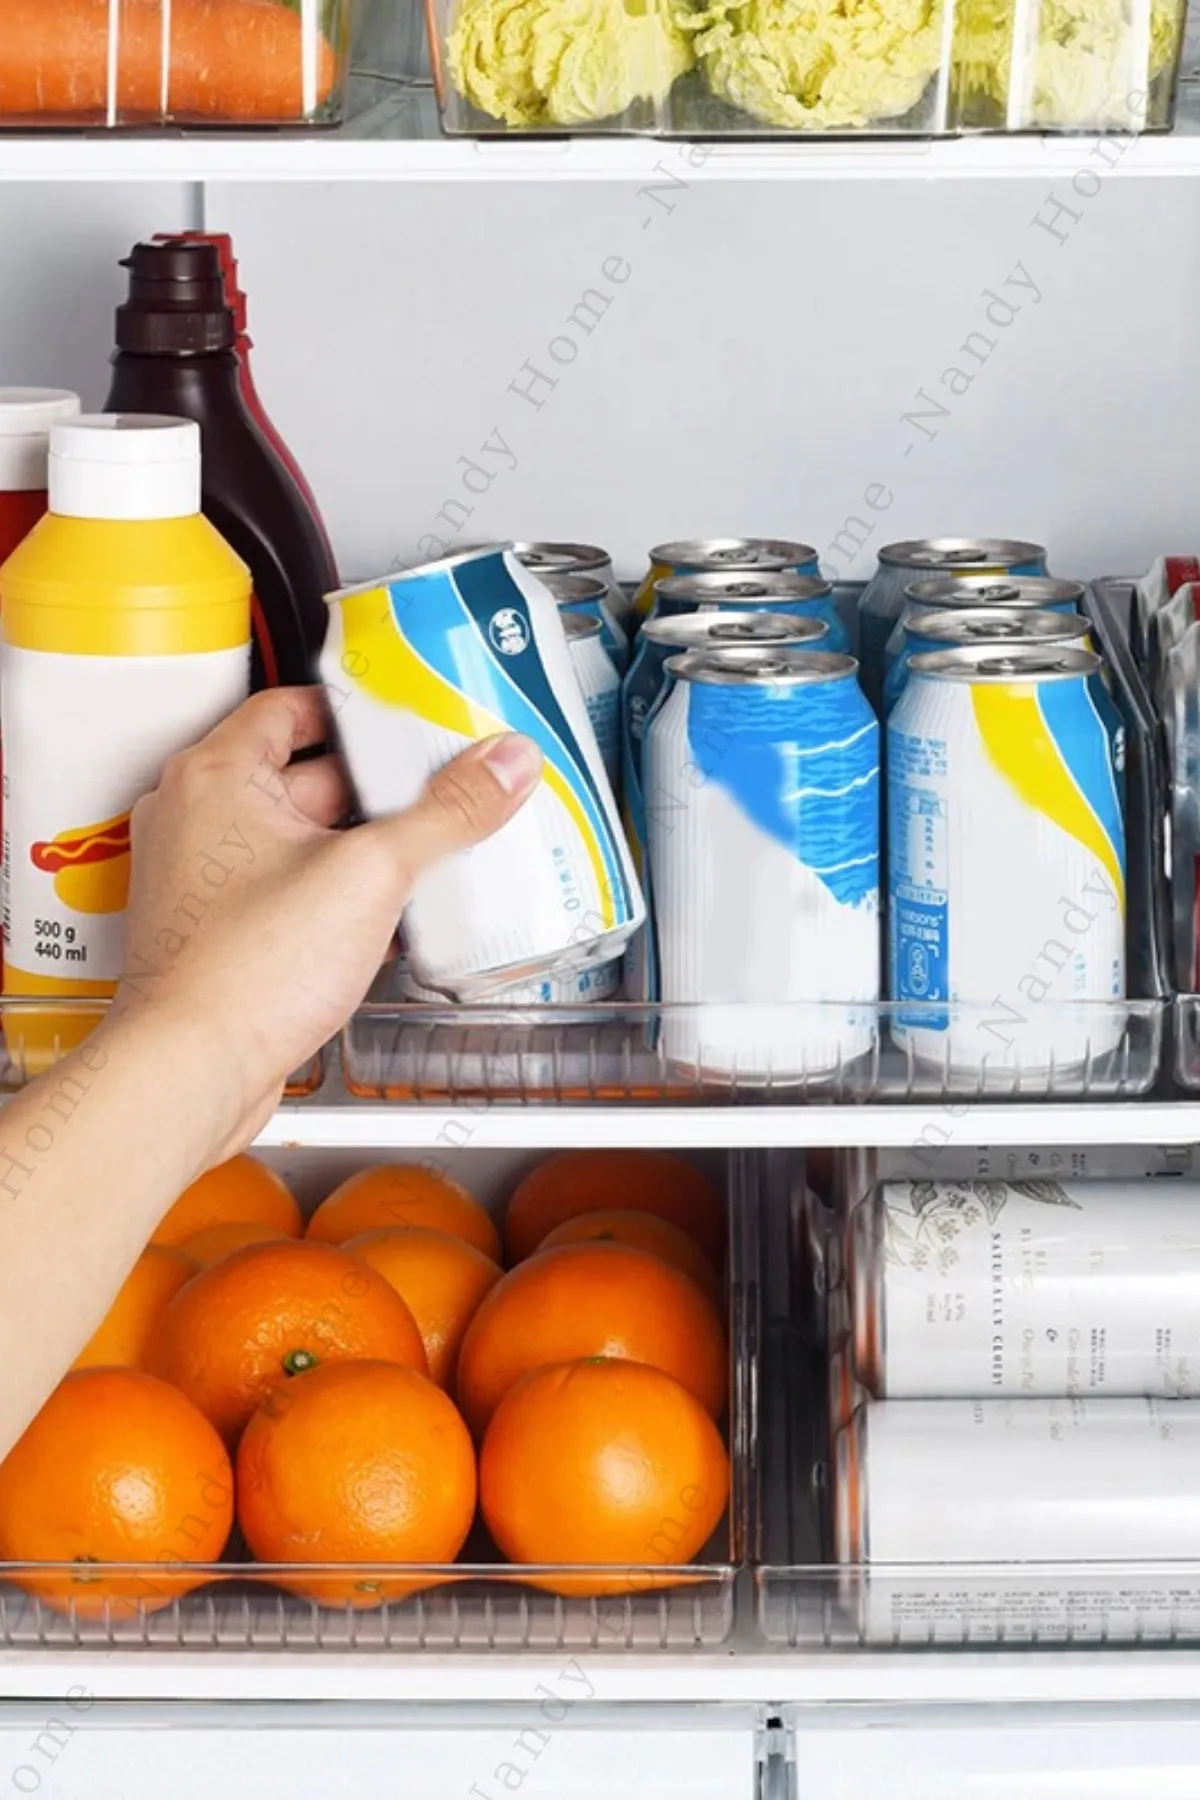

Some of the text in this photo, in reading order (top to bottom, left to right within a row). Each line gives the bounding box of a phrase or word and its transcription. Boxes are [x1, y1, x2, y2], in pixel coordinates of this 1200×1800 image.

[34, 919, 76, 943] 500 g
[34, 941, 87, 962] 440 ml
